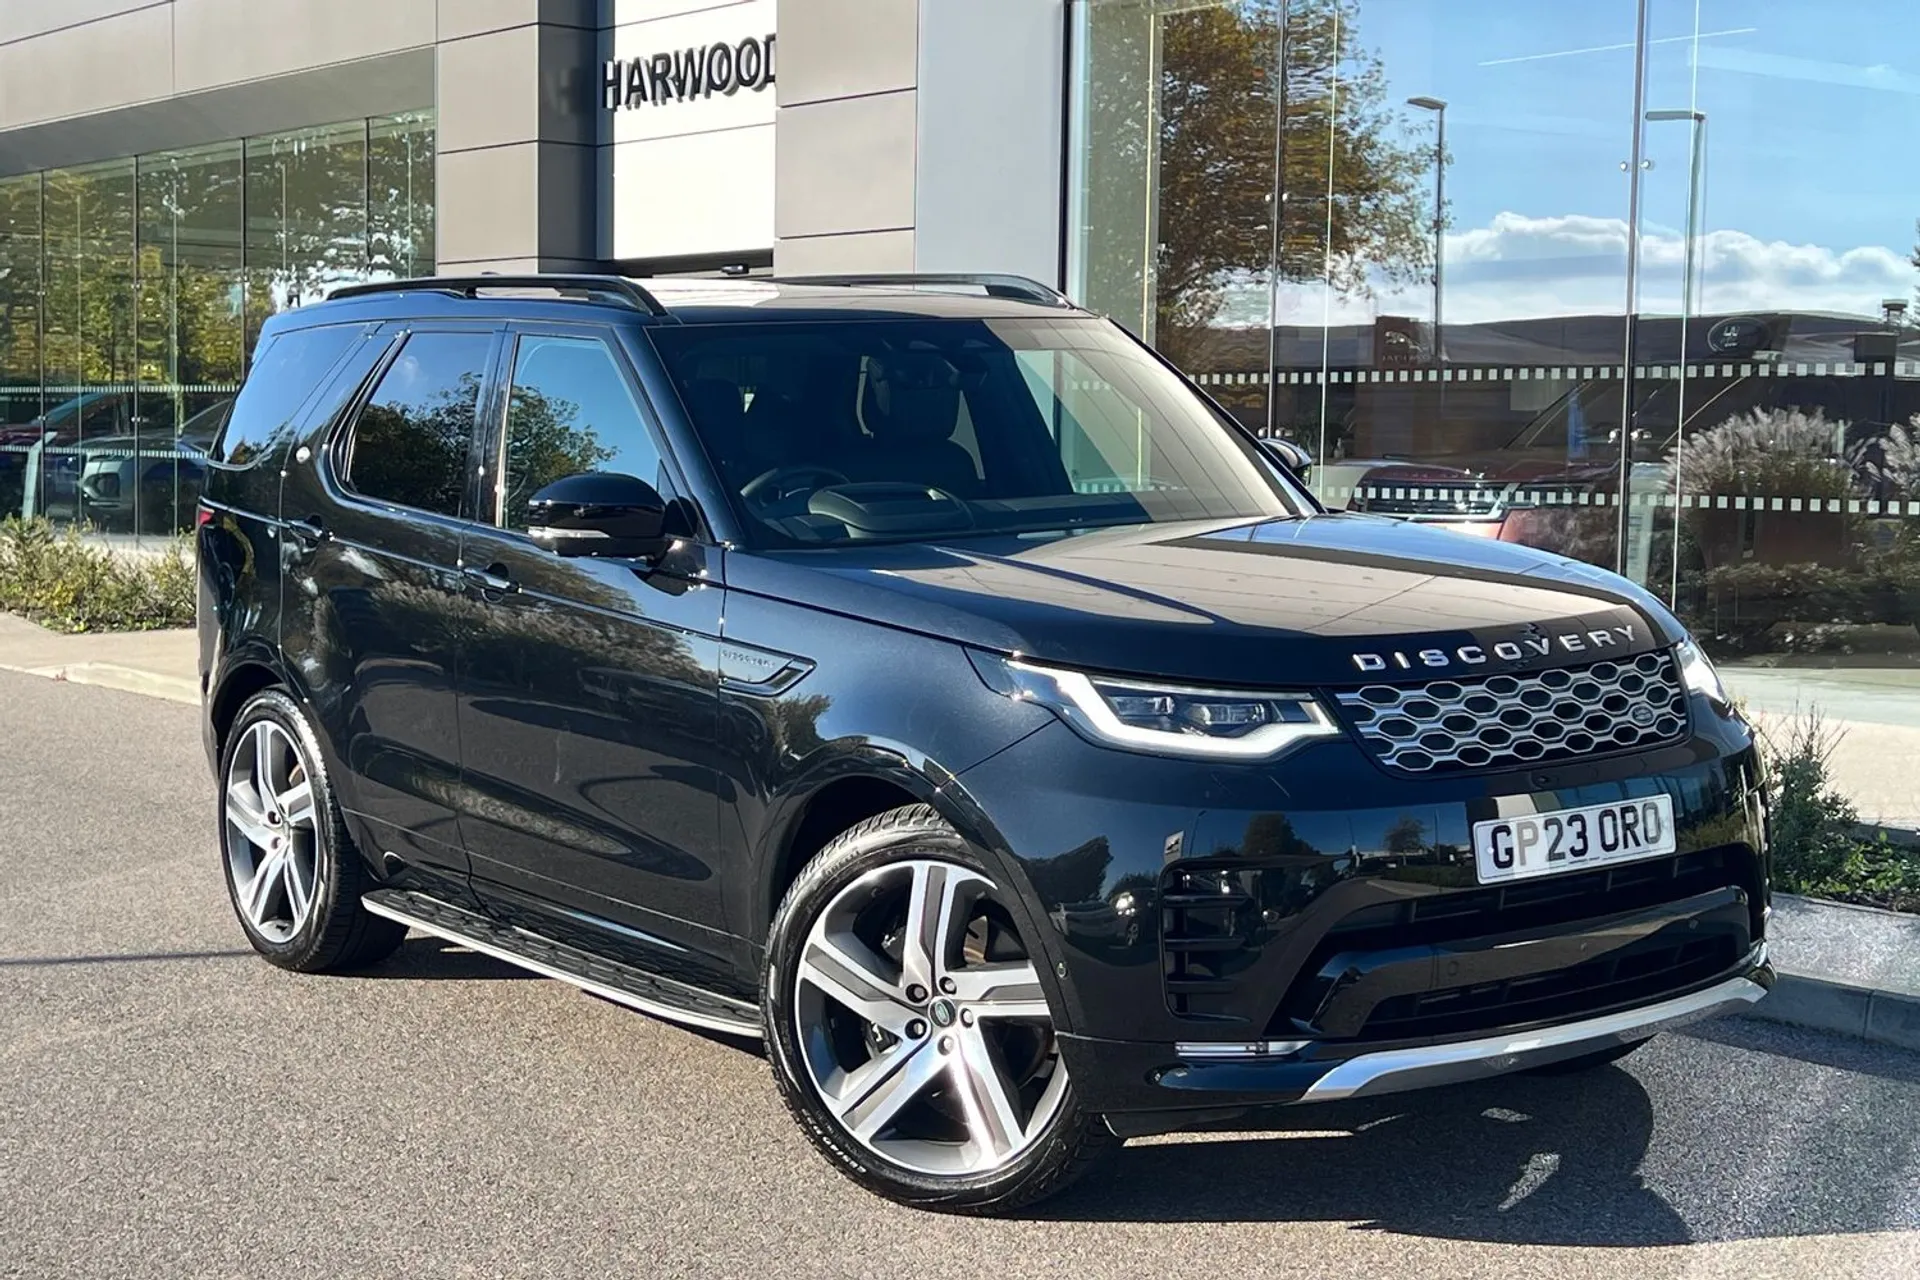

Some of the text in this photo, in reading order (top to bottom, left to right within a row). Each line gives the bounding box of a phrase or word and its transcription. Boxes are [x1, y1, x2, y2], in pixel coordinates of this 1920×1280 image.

[1352, 624, 1636, 671] DISCOVERY
[1491, 801, 1662, 869] GP23 ORO
